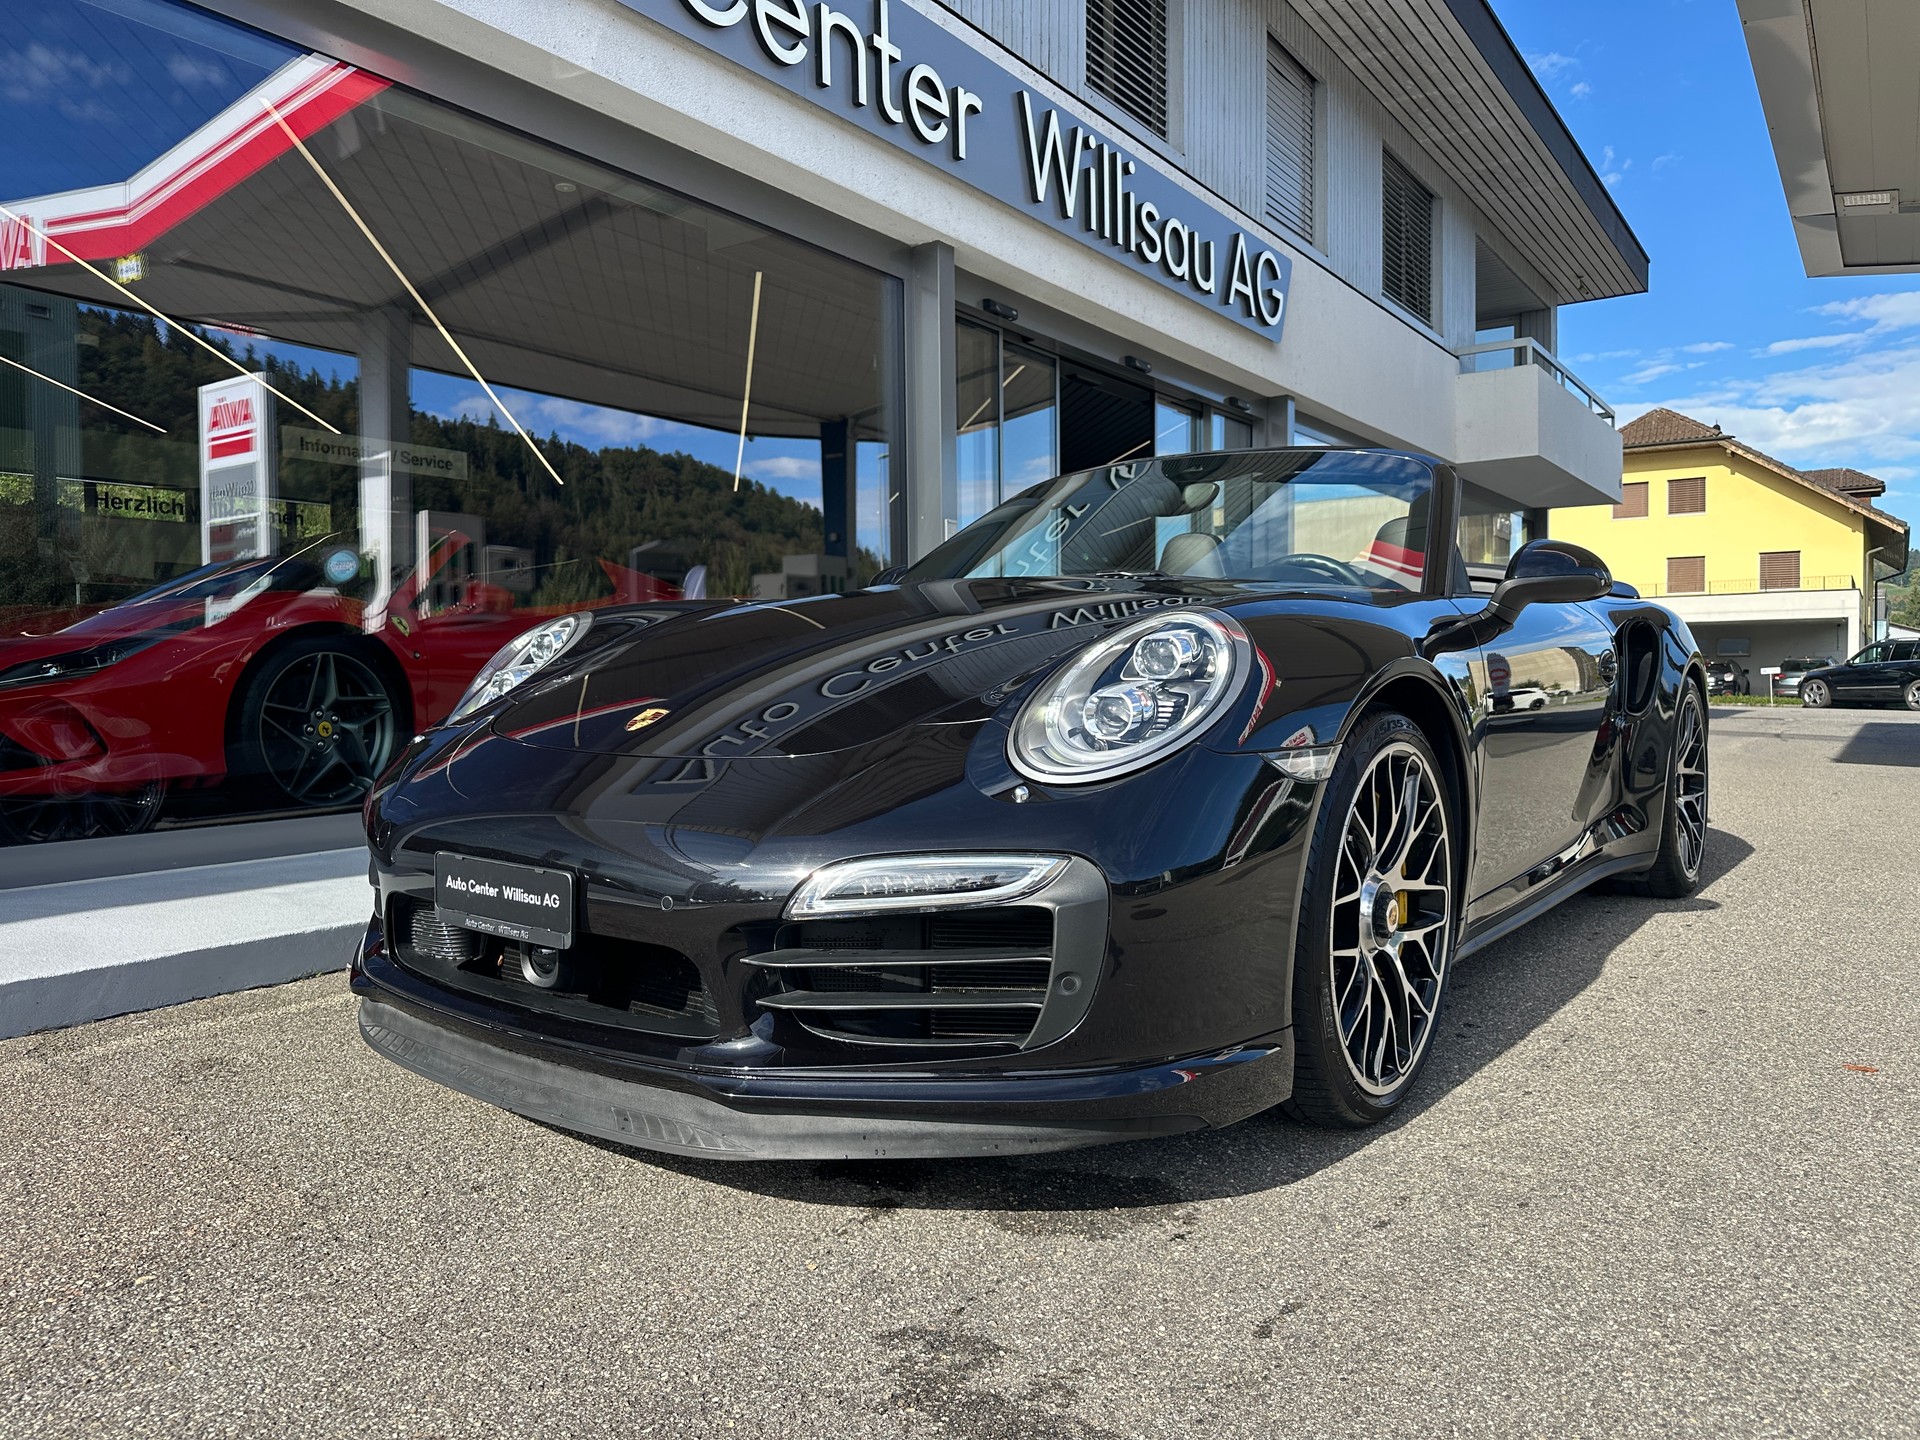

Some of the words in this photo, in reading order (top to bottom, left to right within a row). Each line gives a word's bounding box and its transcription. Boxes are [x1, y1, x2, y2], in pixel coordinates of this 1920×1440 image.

[681, 0, 983, 162] enter
[1017, 89, 1215, 295] Willisau
[1227, 231, 1284, 328] AG
[300, 436, 389, 463] Informatio
[400, 450, 454, 471] Service
[97, 490, 185, 516] Herzlich
[446, 874, 467, 891] Auto
[468, 879, 499, 898] Center
[502, 884, 542, 906] Willisau
[543, 892, 560, 908] AG
[464, 918, 478, 928] Auto
[478, 921, 495, 932] Center
[498, 924, 519, 938] Willisau
[519, 931, 529, 939] AG
